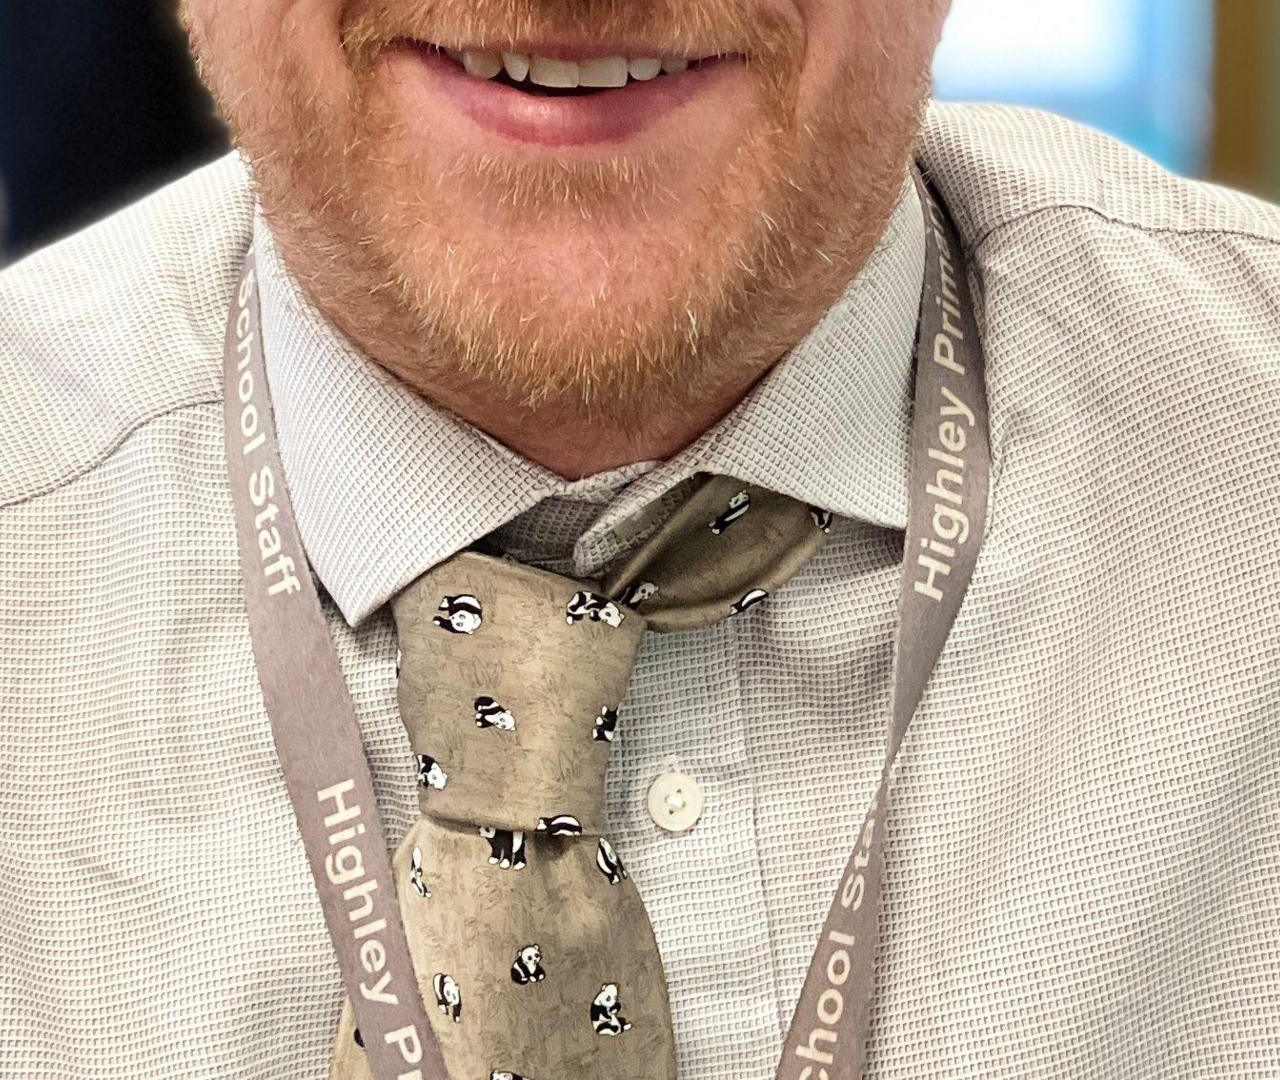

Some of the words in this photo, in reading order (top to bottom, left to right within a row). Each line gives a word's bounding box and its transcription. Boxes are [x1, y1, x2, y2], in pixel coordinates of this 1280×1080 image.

[235, 269, 266, 455] School
[248, 466, 301, 596] Staff
[915, 387, 976, 601] Highley
[317, 779, 399, 1005] Highley
[841, 801, 878, 911] Sta
